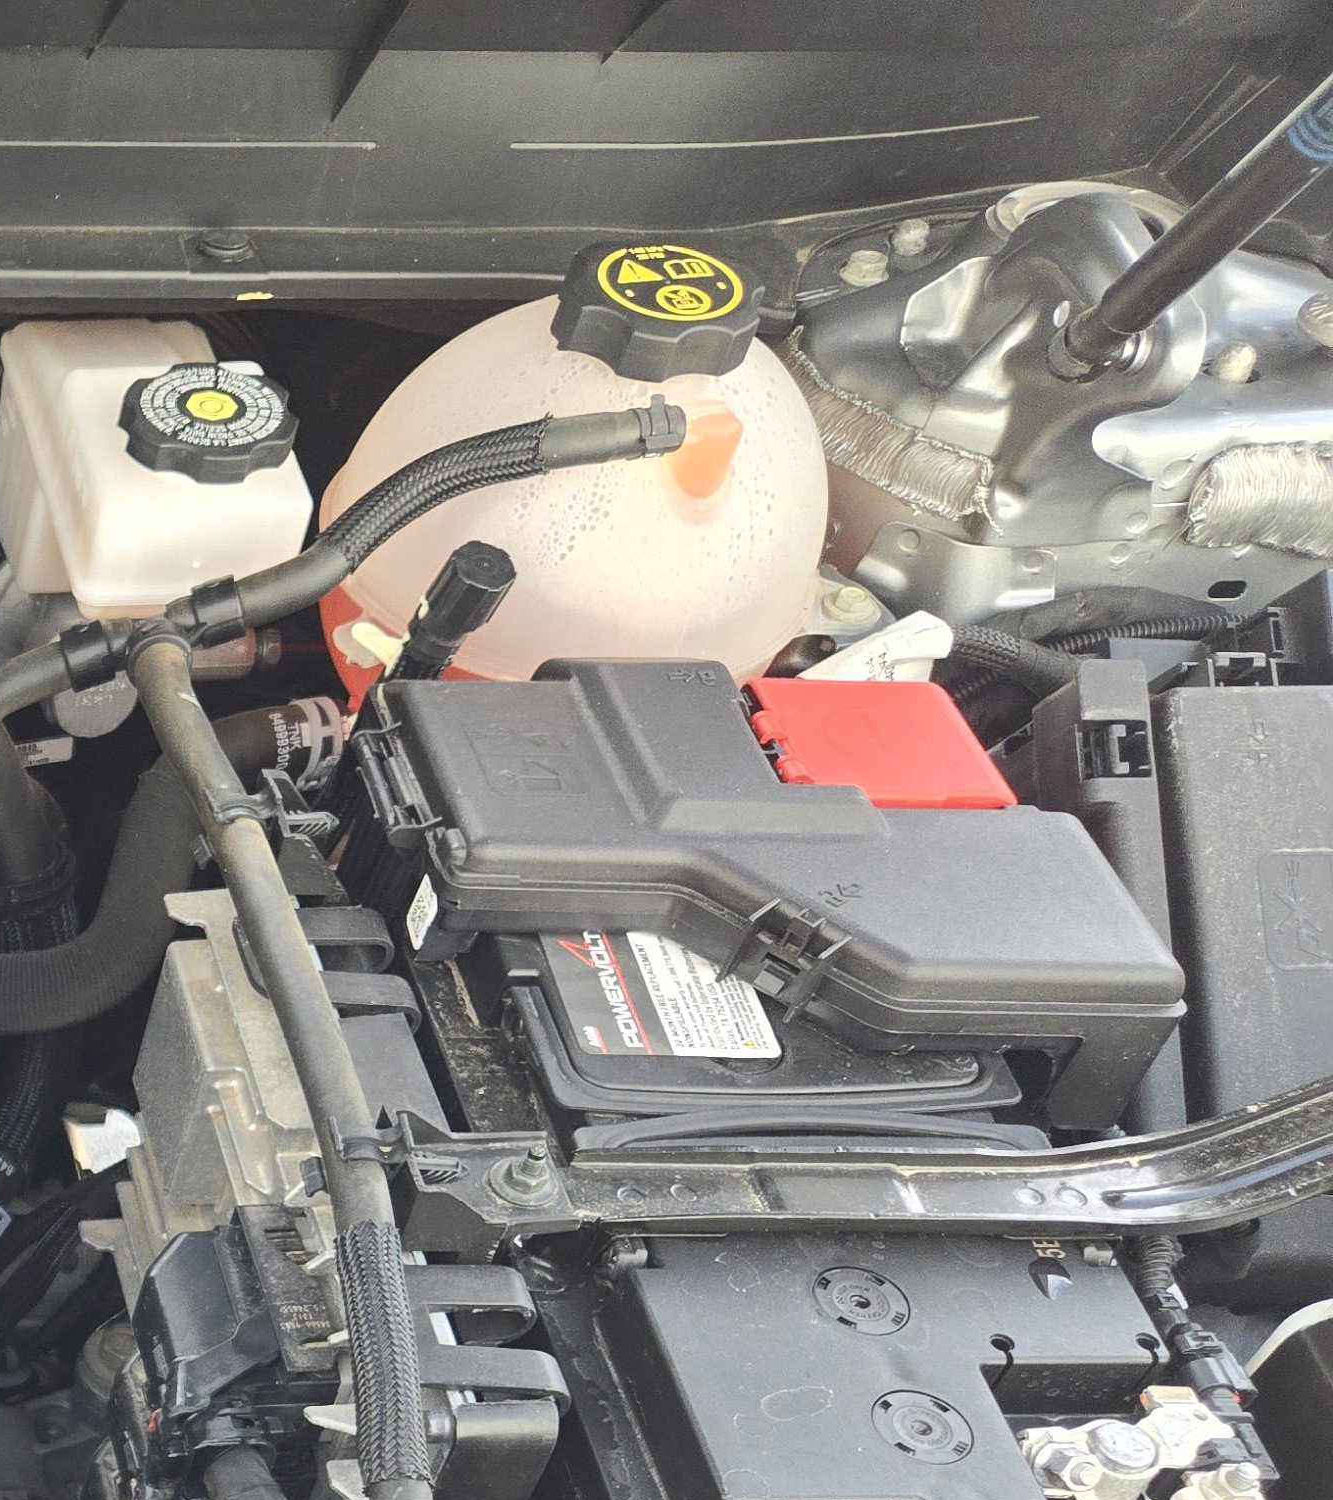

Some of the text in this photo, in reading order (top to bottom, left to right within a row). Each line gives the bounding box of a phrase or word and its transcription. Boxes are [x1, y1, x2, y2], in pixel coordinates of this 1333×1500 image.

[287, 720, 301, 751] TNK
[582, 932, 644, 1047] POWERVOLT
[634, 943, 660, 991] REPLACEMENT
